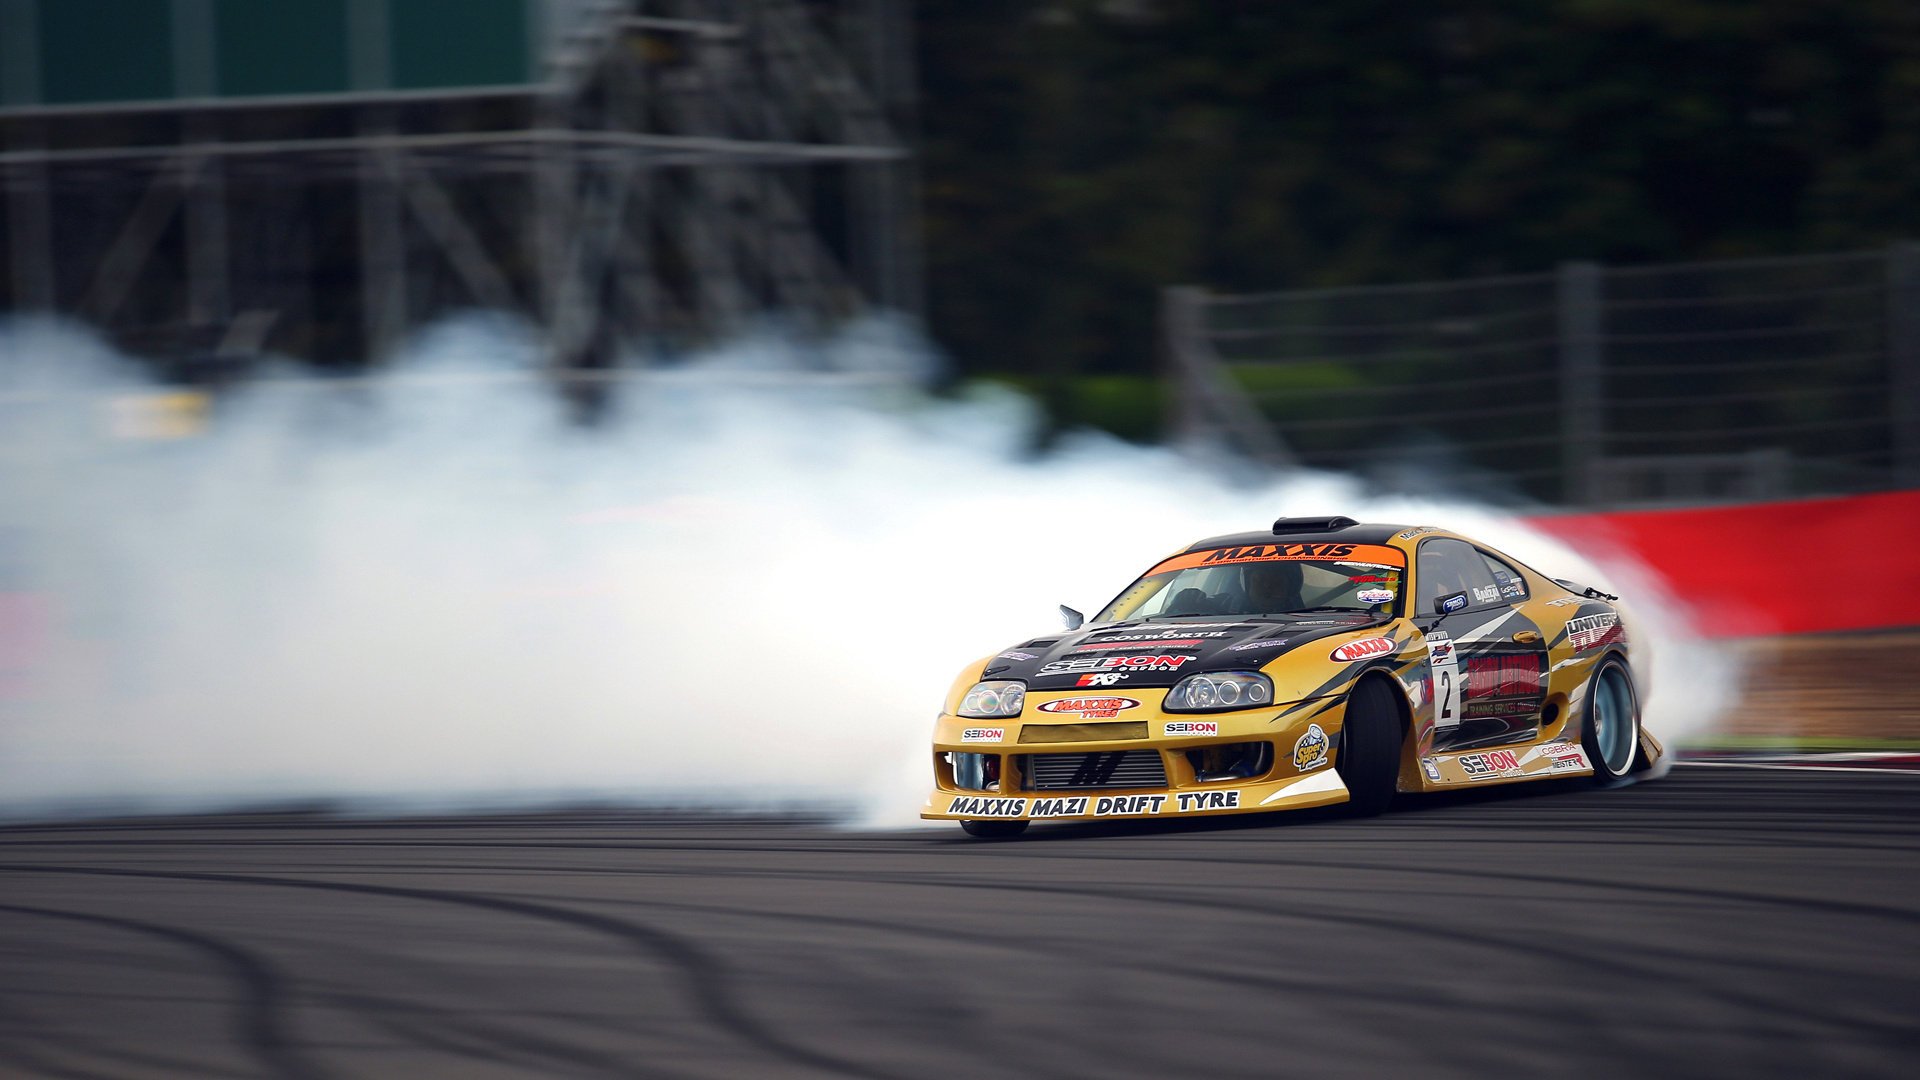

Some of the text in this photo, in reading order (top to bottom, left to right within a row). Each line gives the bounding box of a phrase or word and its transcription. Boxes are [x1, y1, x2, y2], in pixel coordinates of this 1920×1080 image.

[1203, 544, 1357, 562] MAXXIS
[1100, 631, 1228, 642] COSWORTH
[1341, 637, 1389, 660] MAXXIS
[1042, 655, 1187, 676] SEIBON
[1441, 671, 1452, 719] 2
[1053, 699, 1124, 712] MAXXIS
[1082, 710, 1118, 719] TYRES
[963, 729, 1002, 739] SEIBON
[1166, 723, 1216, 732] SEIBON
[1541, 742, 1577, 755] COBRA
[1459, 750, 1519, 774] SEIBON
[949, 791, 1239, 816] MAXXIS MAZI DRIFT TYRE
